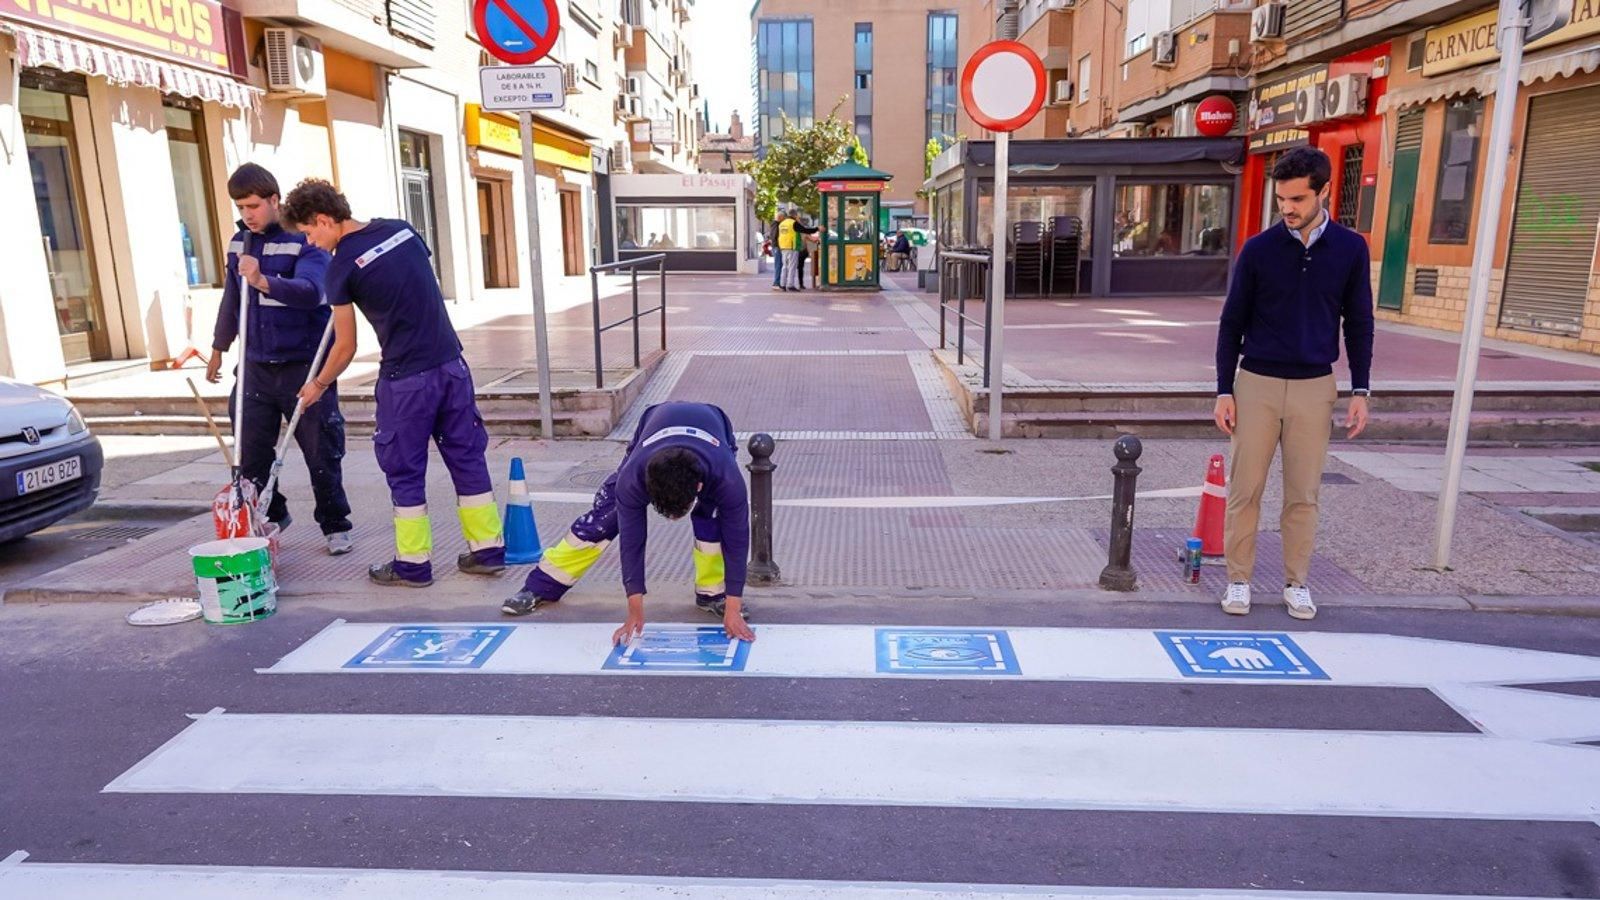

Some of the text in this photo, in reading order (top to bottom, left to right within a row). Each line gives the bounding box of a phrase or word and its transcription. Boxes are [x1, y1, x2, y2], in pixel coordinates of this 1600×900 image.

[66, 0, 213, 46] BACOS
[1425, 22, 1498, 64] CARNICE
[26, 460, 78, 489] 2149 BZP
